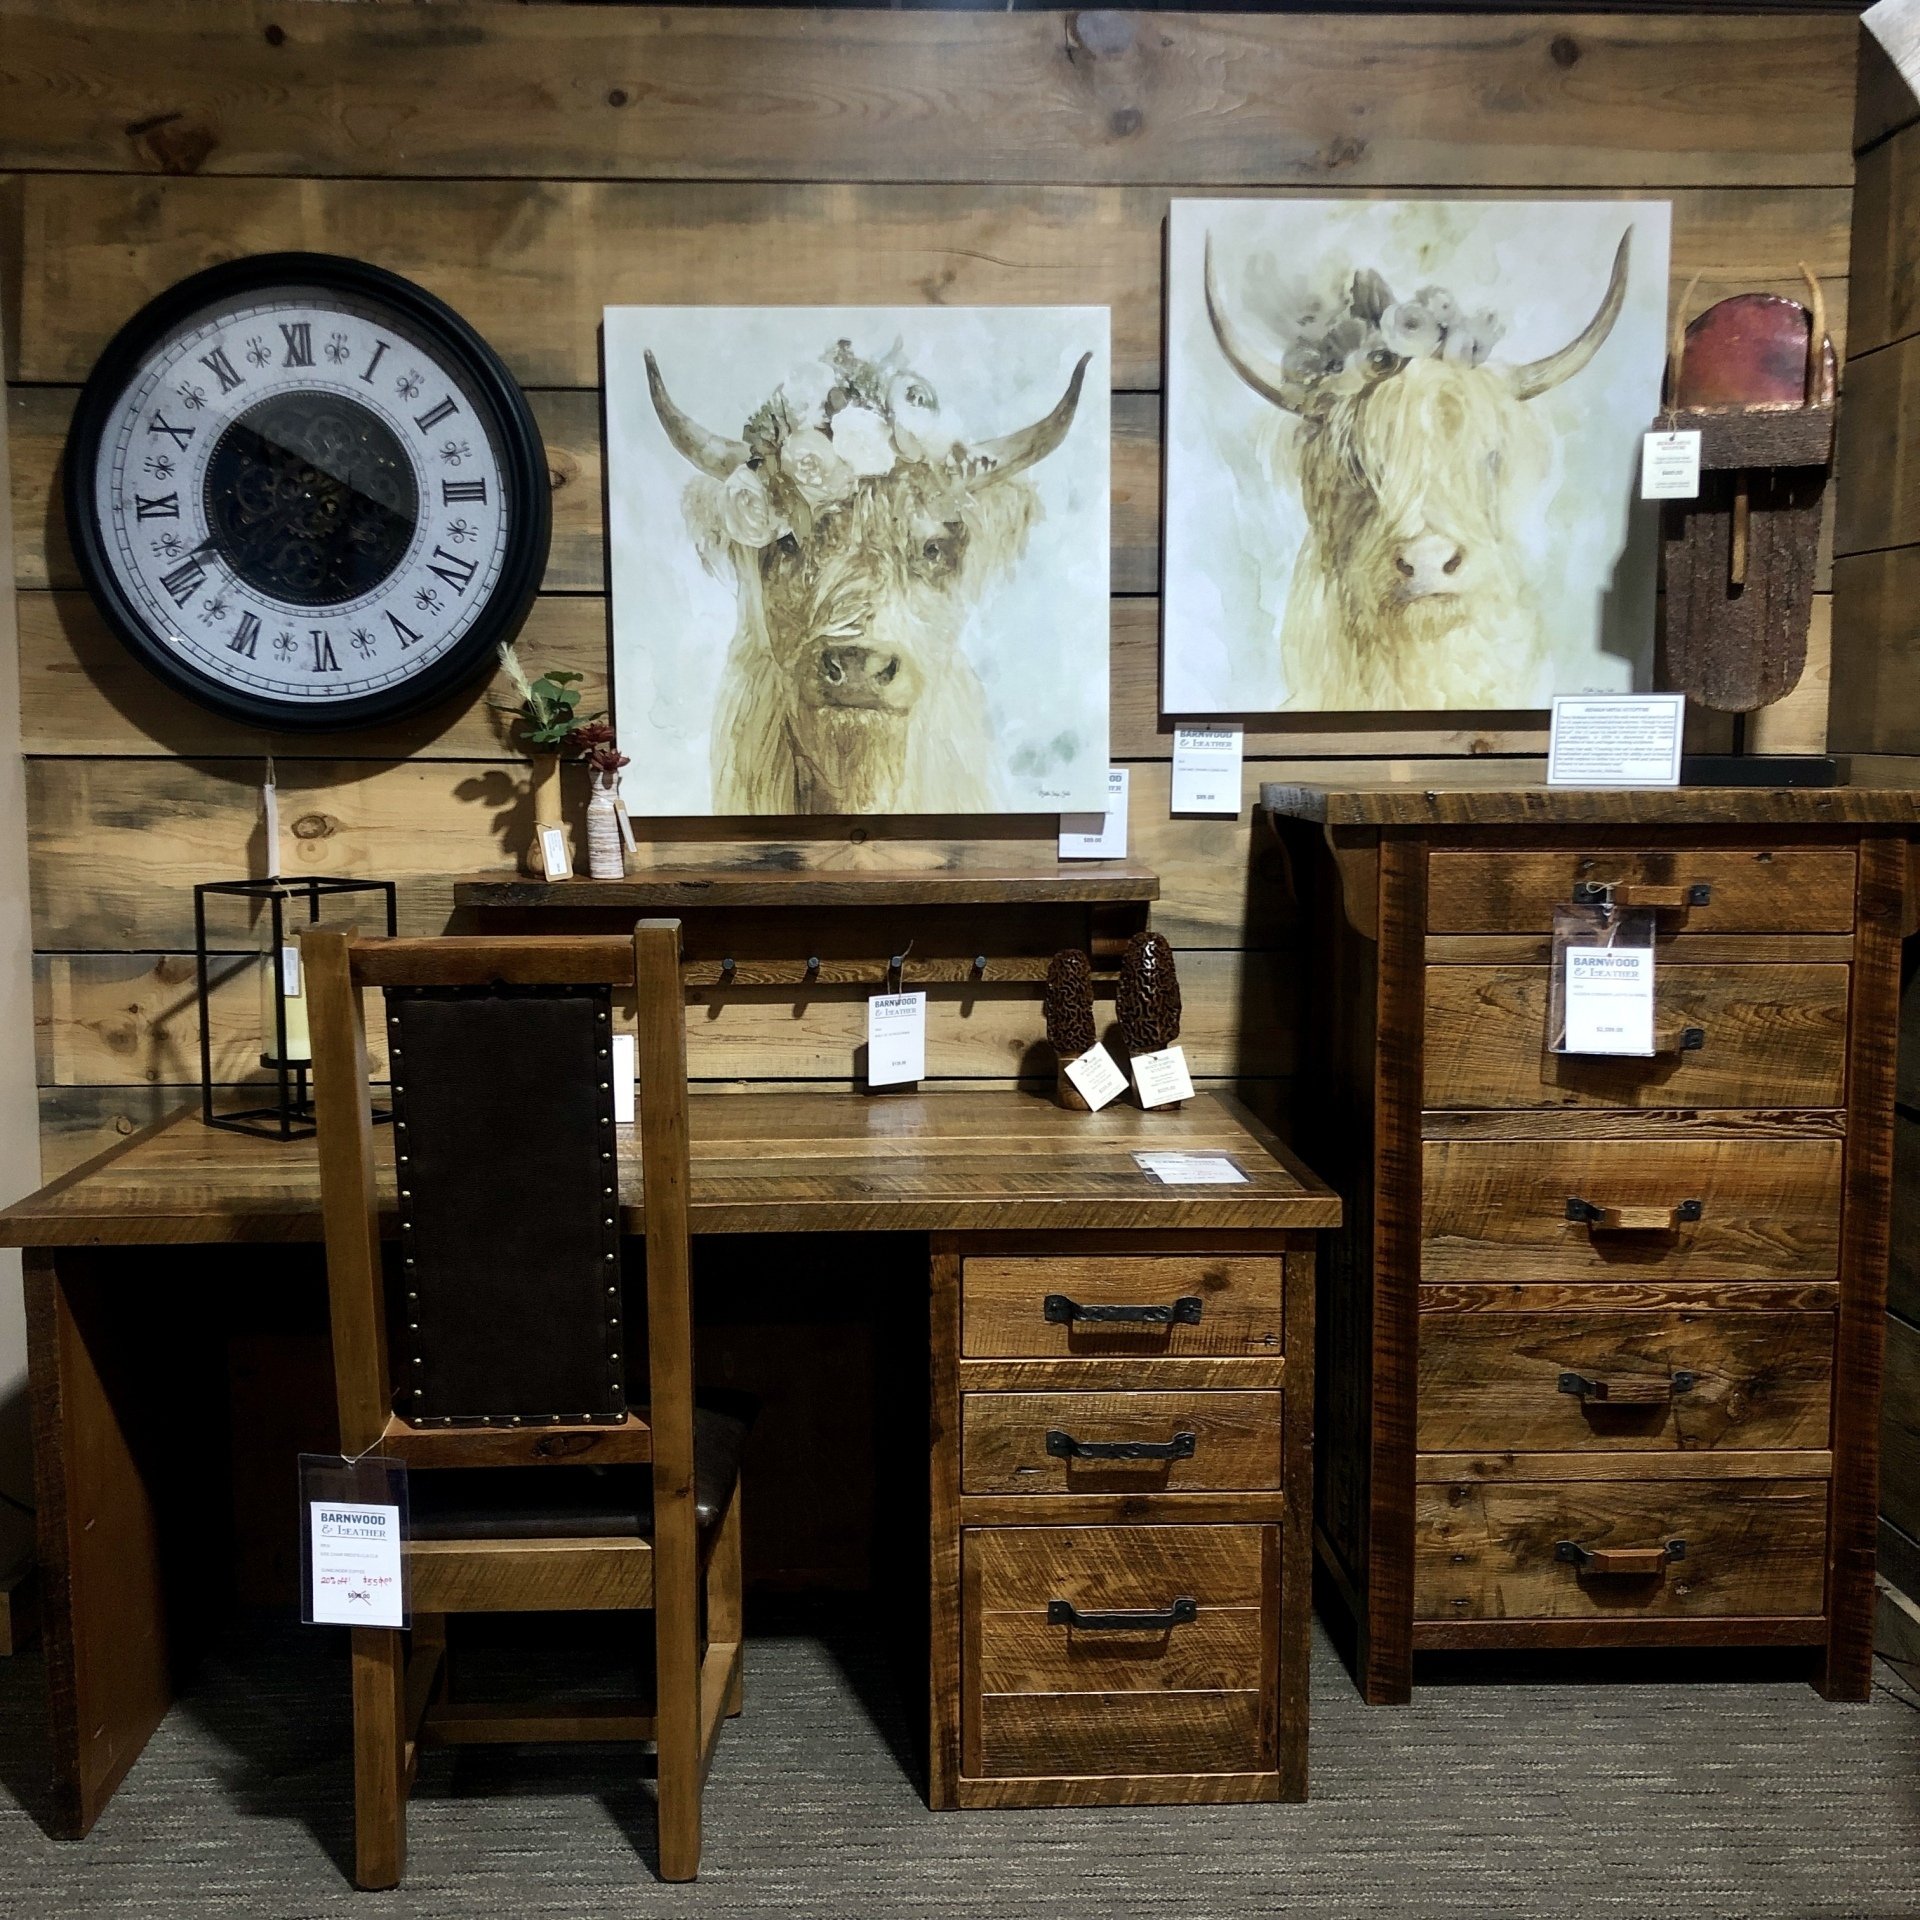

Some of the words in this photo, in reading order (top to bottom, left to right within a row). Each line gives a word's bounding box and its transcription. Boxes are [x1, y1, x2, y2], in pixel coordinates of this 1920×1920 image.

[279, 323, 316, 367] XII
[360, 340, 391, 384] I
[200, 345, 245, 393] XI
[149, 409, 196, 452] X
[414, 395, 461, 435] II
[135, 492, 180, 522] IX
[442, 477, 488, 506] III
[159, 555, 208, 610] VIII
[427, 545, 479, 597] IV
[227, 612, 263, 661] VII
[385, 609, 424, 650] V
[309, 630, 342, 672] VI
[1180, 730, 1233, 739] BARNWOOD
[1573, 957, 1640, 967] BARNWOOD
[1574, 967, 1586, 976] &
[1590, 968, 1639, 978] LEATHER
[875, 998, 917, 1008] BARNWOOD
[885, 1008, 917, 1016] LEATHER
[321, 1512, 386, 1525] BARNWOOD
[321, 1525, 333, 1534] &
[337, 1525, 386, 1538] LEATHER
